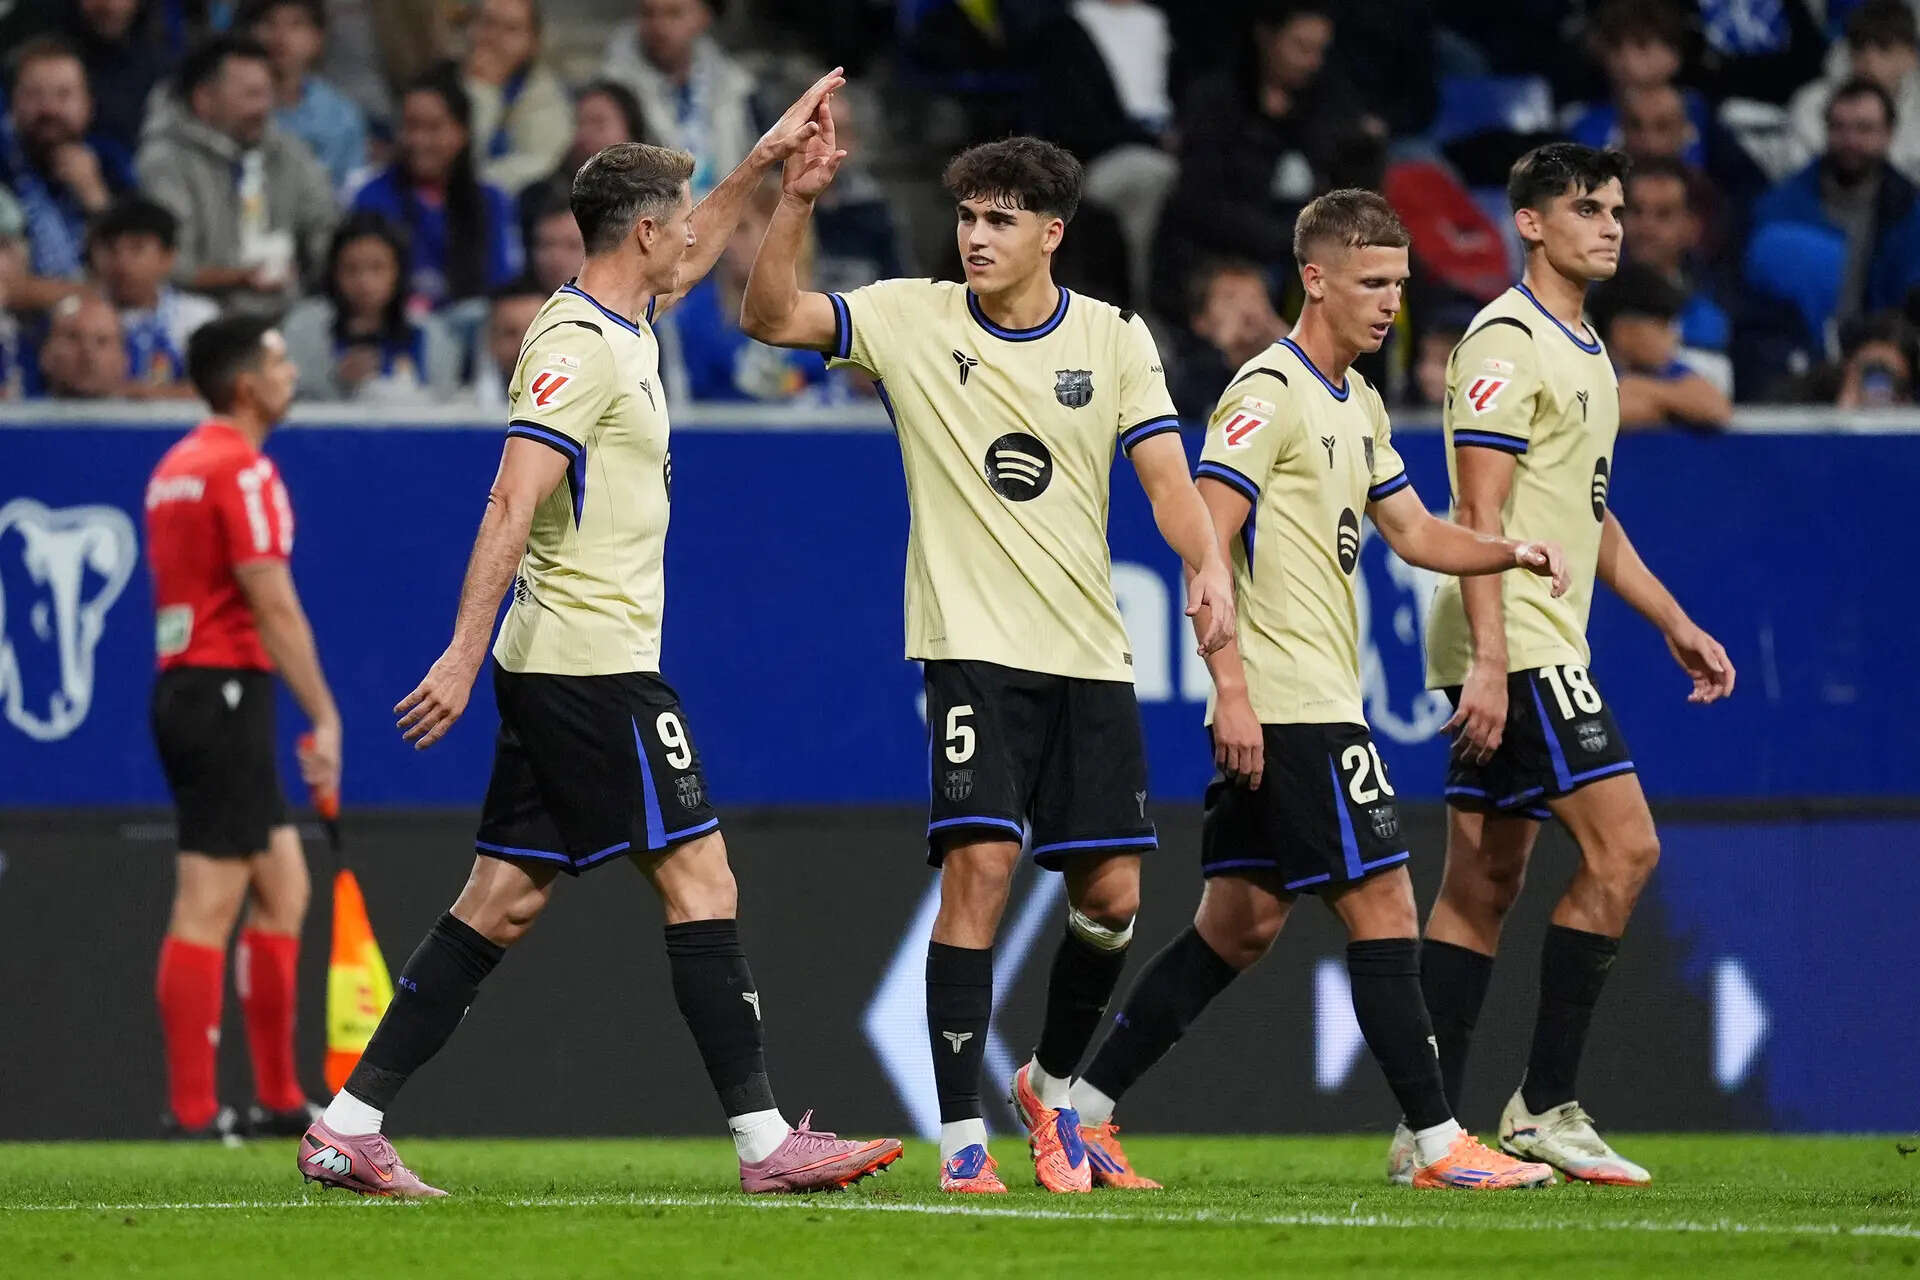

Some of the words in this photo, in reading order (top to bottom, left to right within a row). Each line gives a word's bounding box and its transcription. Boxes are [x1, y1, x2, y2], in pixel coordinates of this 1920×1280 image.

[1539, 664, 1602, 720] 18
[656, 712, 692, 770] 9
[945, 705, 975, 764] 5
